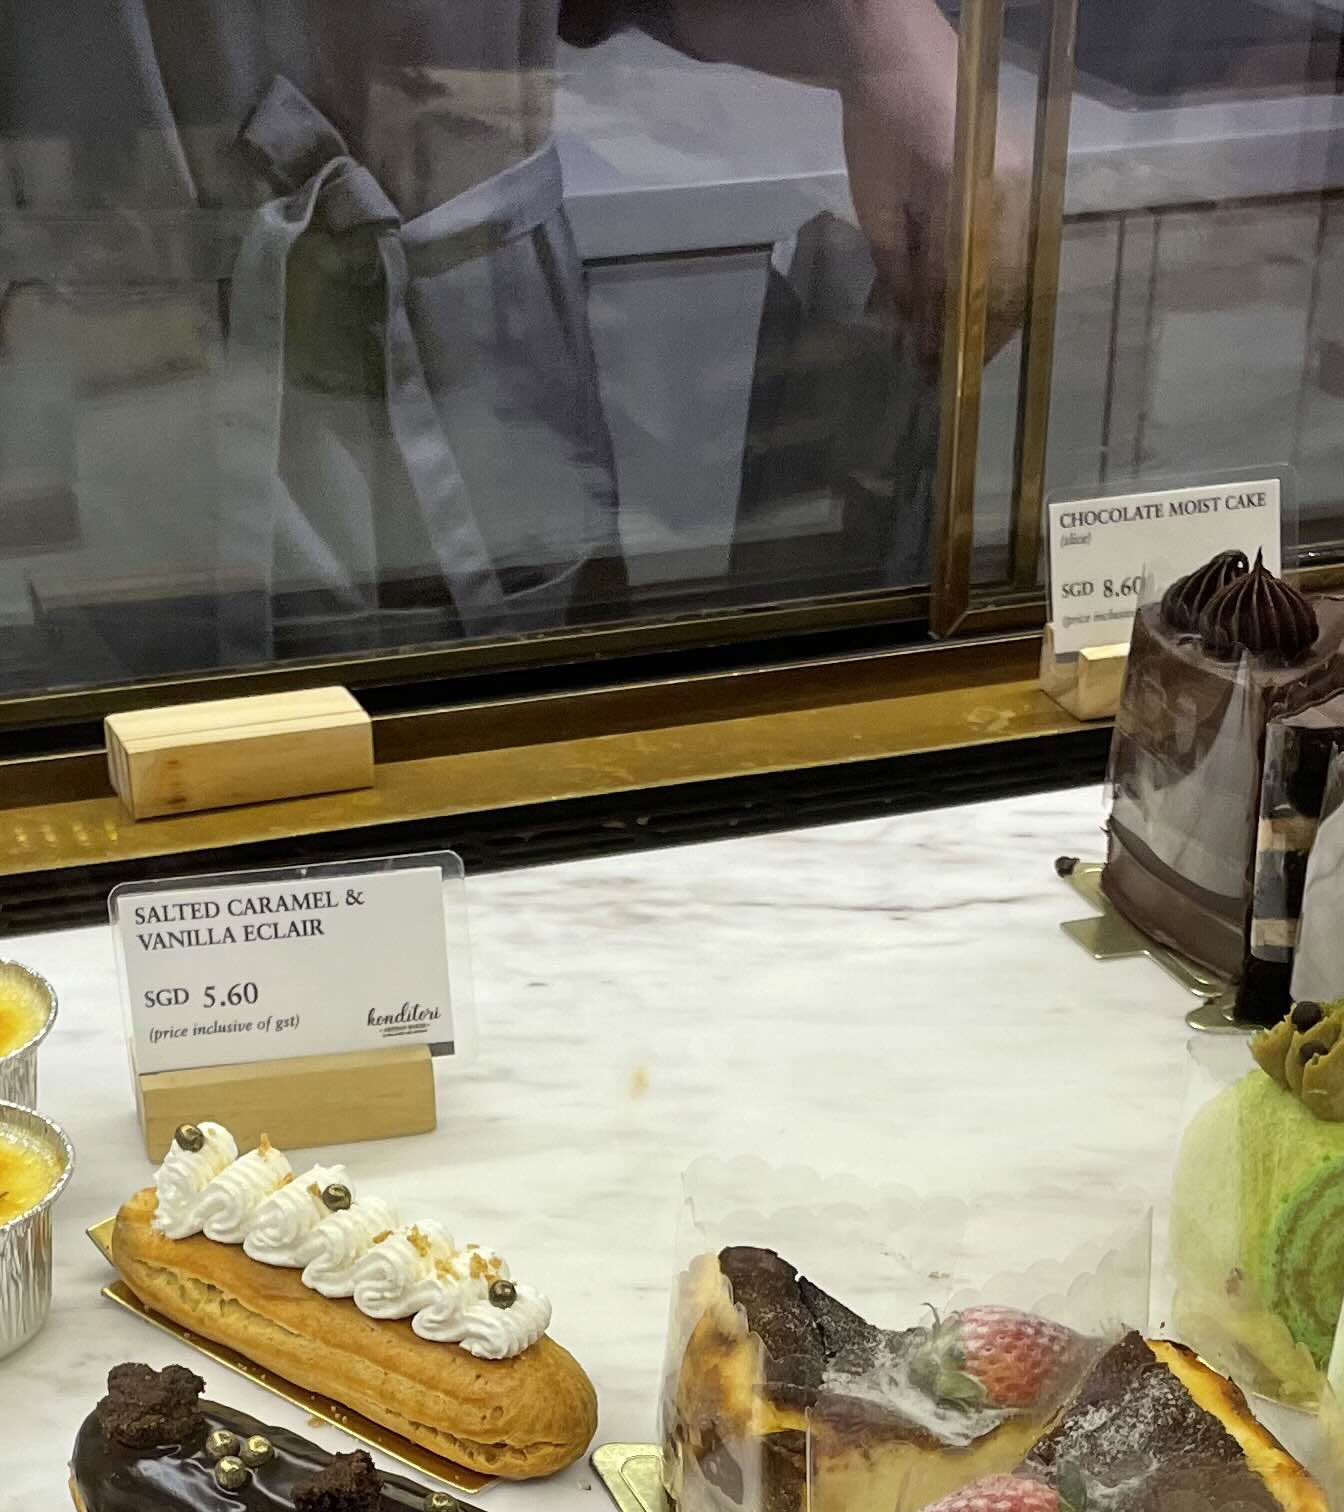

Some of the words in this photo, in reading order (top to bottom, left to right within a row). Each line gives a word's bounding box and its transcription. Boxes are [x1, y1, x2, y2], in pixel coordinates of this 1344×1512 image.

[1060, 504, 1164, 529] CHOCOLATE
[1168, 497, 1221, 517] MOIST
[1225, 492, 1267, 510] CAKE
[1061, 581, 1094, 599] SGD
[1103, 575, 1147, 598] 8.60
[135, 901, 220, 925] SALTED
[227, 891, 339, 916] CARAMEL
[345, 888, 365, 907] &
[137, 928, 235, 951] VANILLA
[244, 918, 325, 941] ECLAIR
[144, 988, 190, 1008] SGD
[203, 982, 259, 1008] 5.60
[149, 1025, 188, 1043] (price
[192, 1019, 253, 1036] inclusive
[257, 1016, 274, 1032] of
[275, 1014, 300, 1033] gst)
[367, 1002, 441, 1028] konditori
